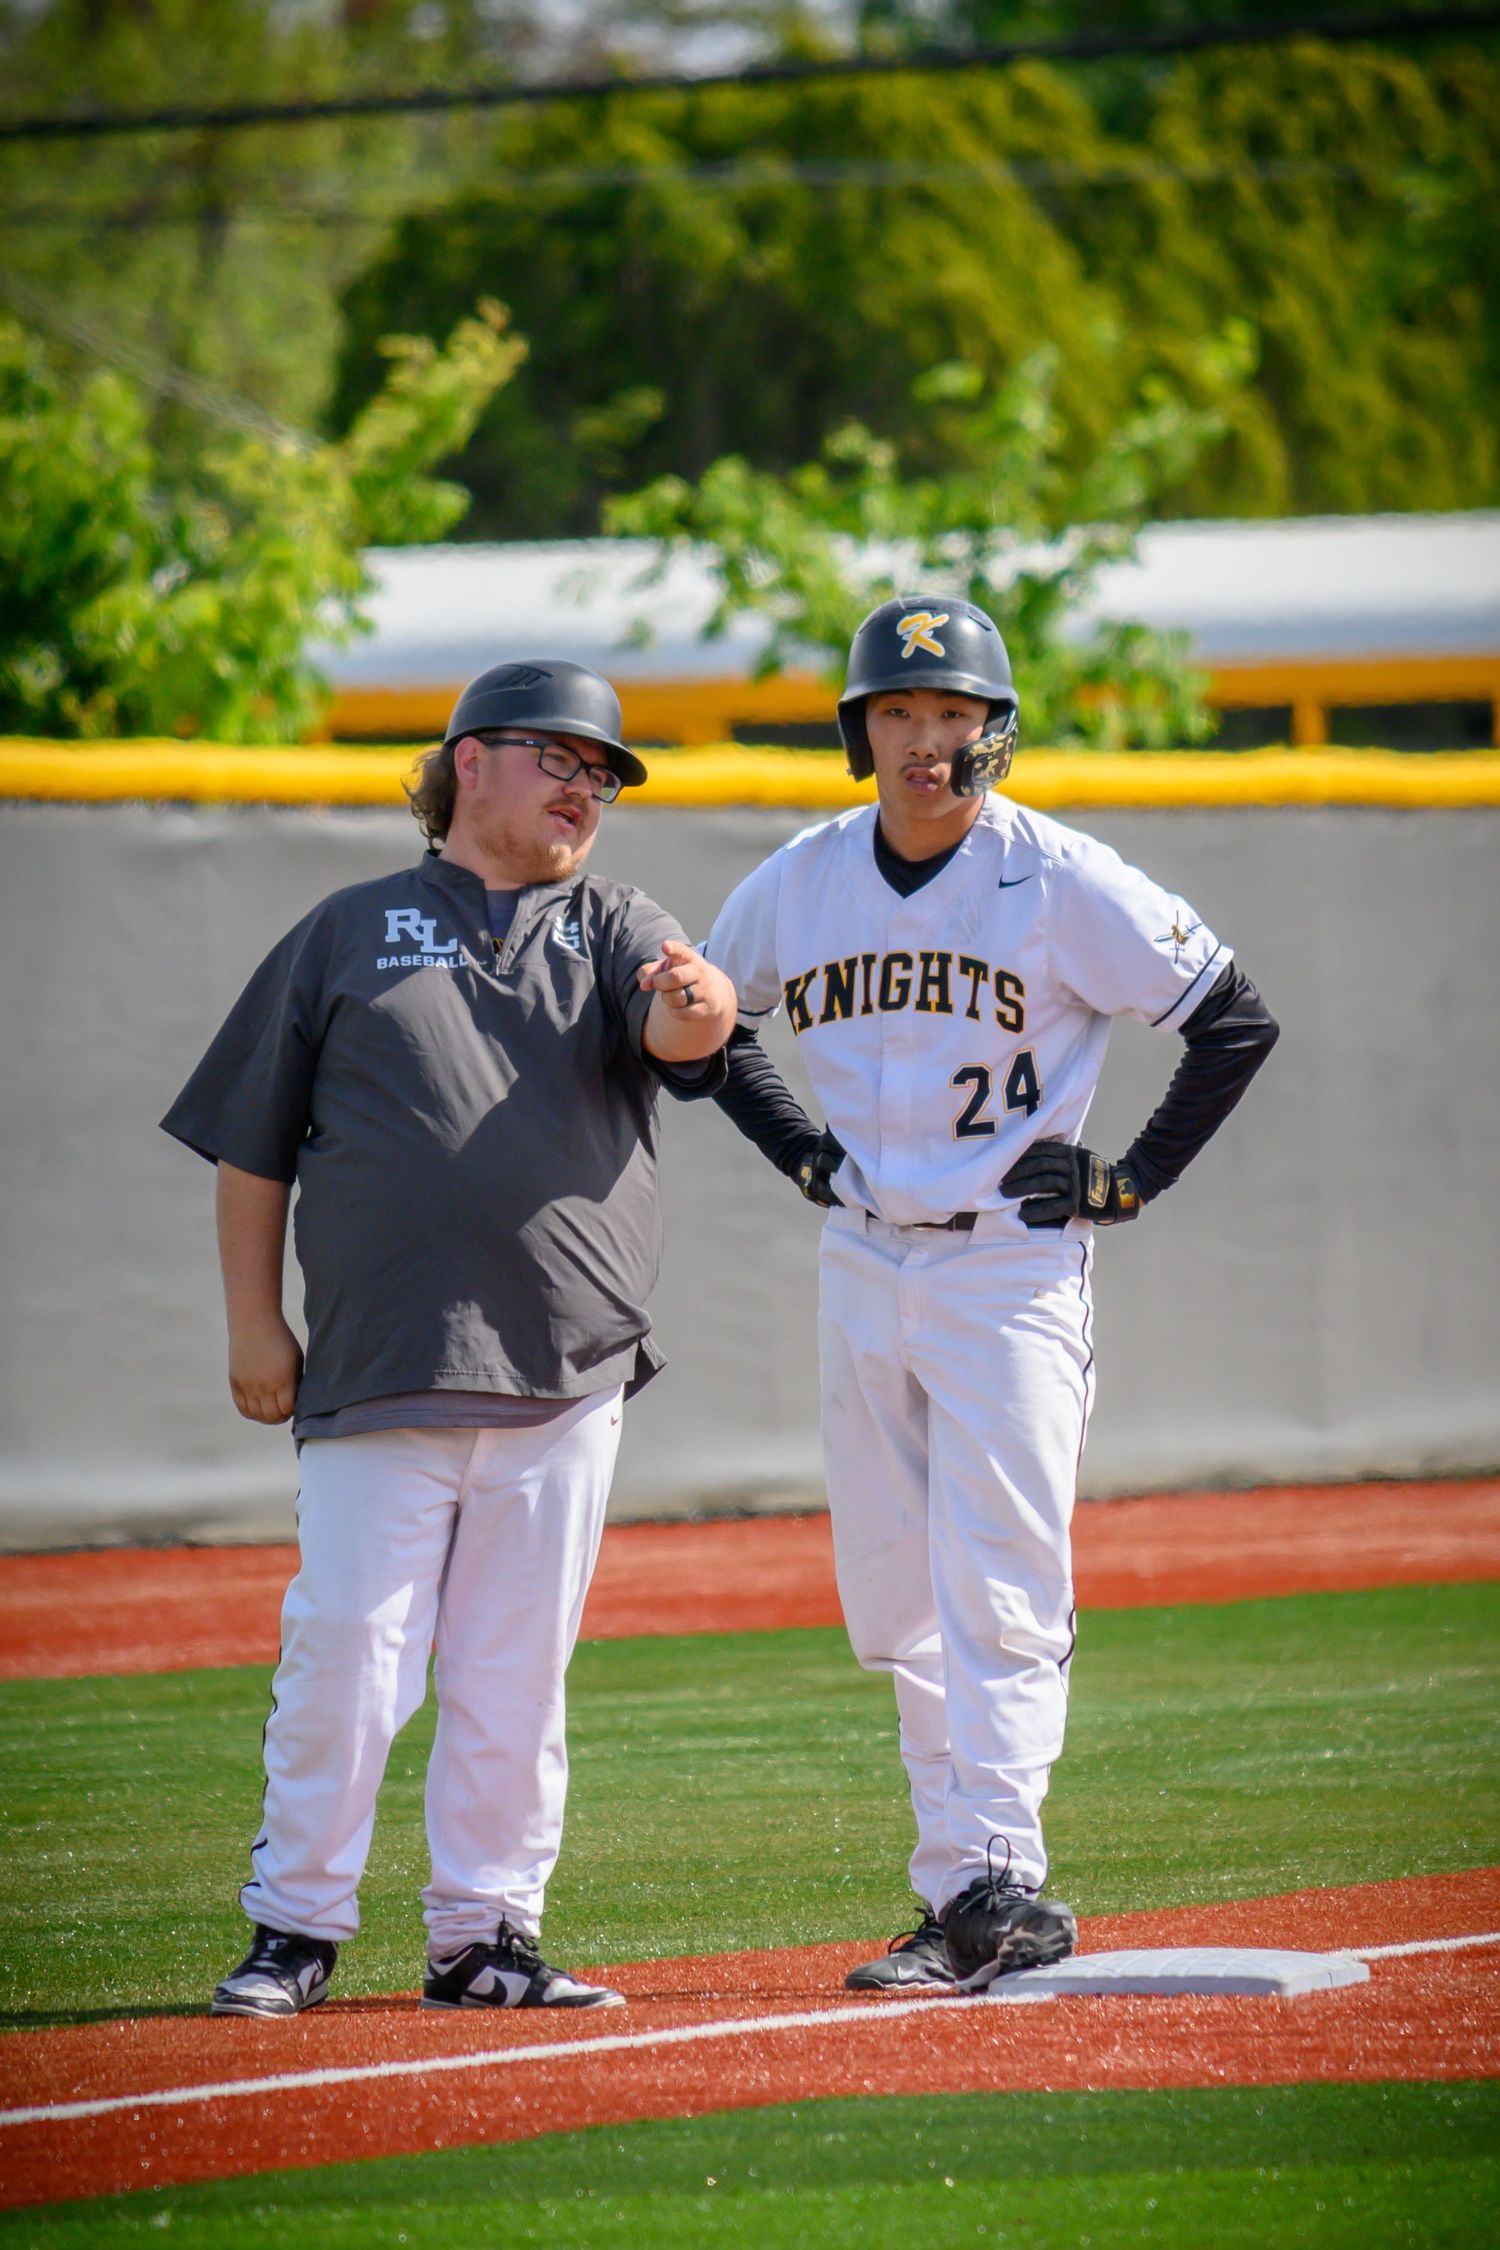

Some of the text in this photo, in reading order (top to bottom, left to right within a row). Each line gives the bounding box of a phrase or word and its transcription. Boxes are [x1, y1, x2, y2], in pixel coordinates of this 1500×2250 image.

[897, 612, 950, 659] K
[385, 908, 458, 953] RL
[376, 953, 468, 970] BASEBALL
[784, 950, 1026, 1036] KNIGHTS
[949, 1046, 1044, 1141] 24
